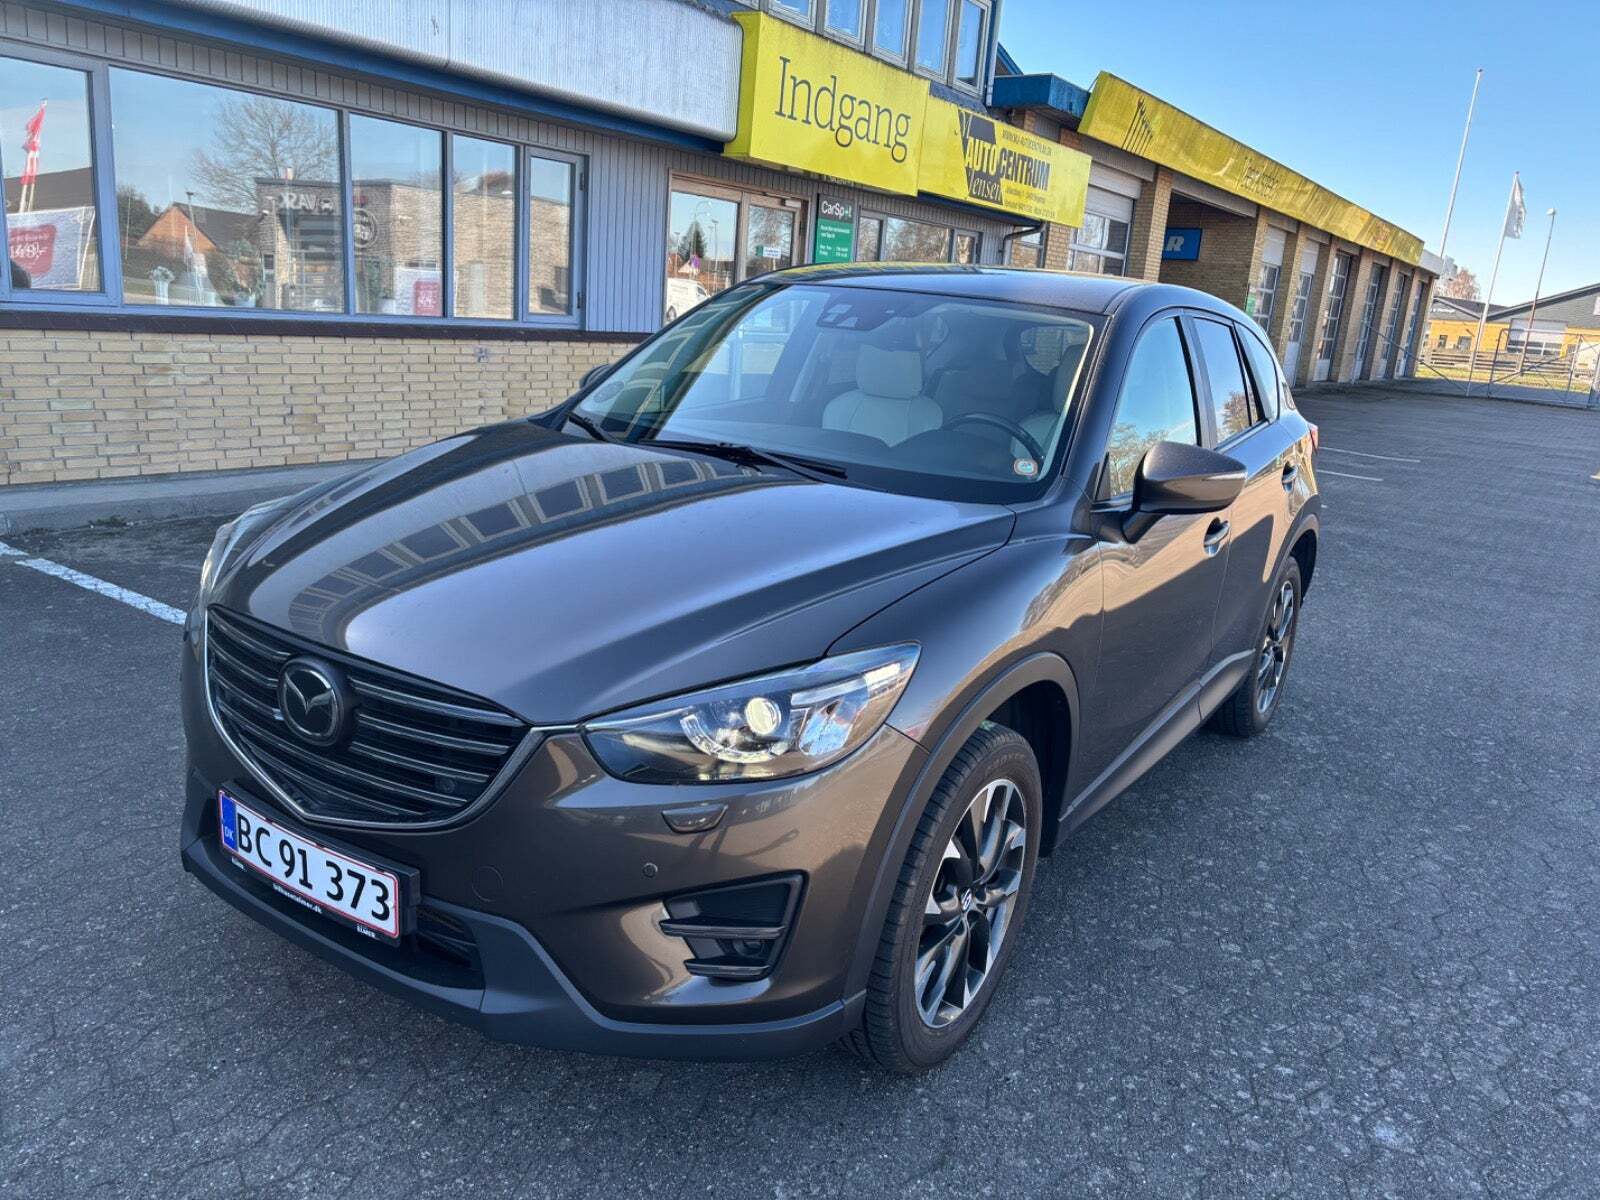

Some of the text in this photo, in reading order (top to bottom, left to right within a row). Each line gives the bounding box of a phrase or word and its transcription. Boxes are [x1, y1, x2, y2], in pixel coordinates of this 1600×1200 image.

[775, 56, 911, 163] Indgang
[965, 136, 1050, 192] AUTO CENTRUM
[967, 169, 1001, 201] Jensen
[224, 826, 234, 841] DK
[237, 813, 272, 867] BC
[279, 839, 313, 890] 91
[326, 860, 390, 921] 373
